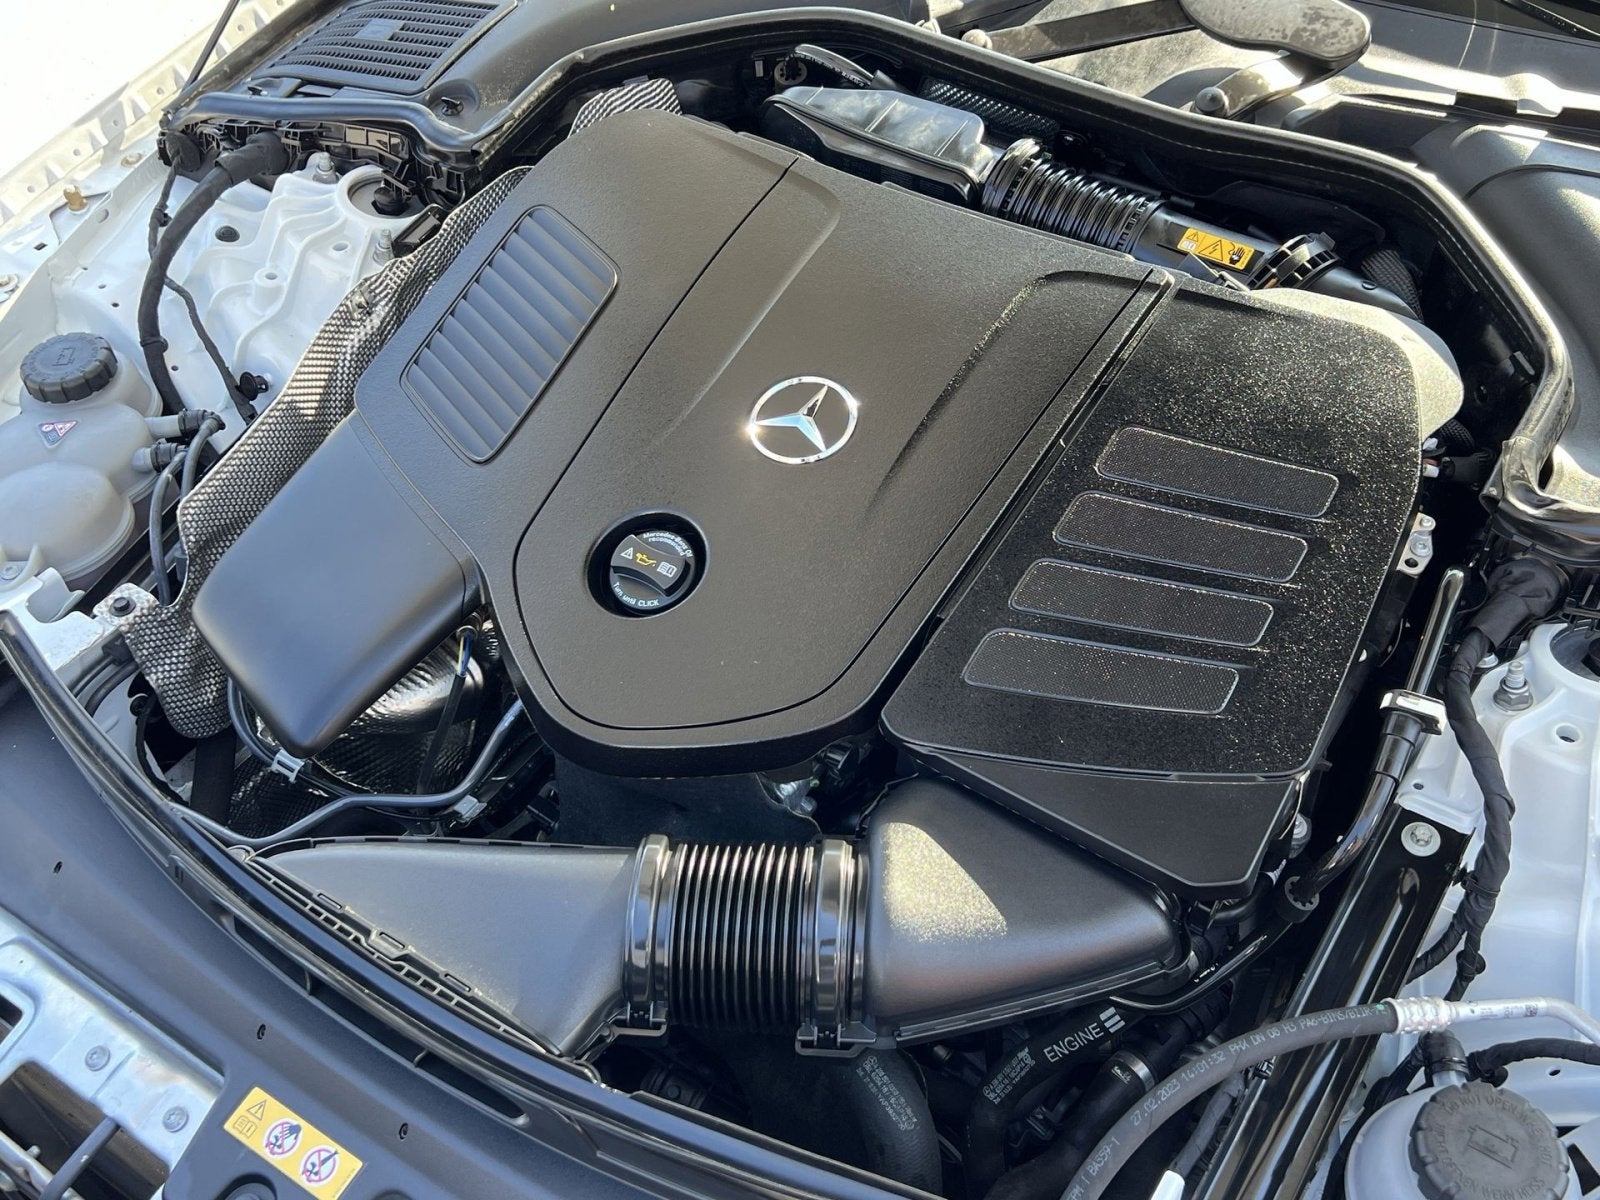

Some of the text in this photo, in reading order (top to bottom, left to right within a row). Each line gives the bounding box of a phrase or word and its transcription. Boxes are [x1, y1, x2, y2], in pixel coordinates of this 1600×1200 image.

[637, 599, 660, 607] CLICK
[1043, 1022, 1105, 1063] ENGINE
[1129, 1079, 1181, 1126] 27.02.2023
[1181, 1052, 1226, 1083] 14:01:32
[1487, 1095, 1518, 1115] OPEN
